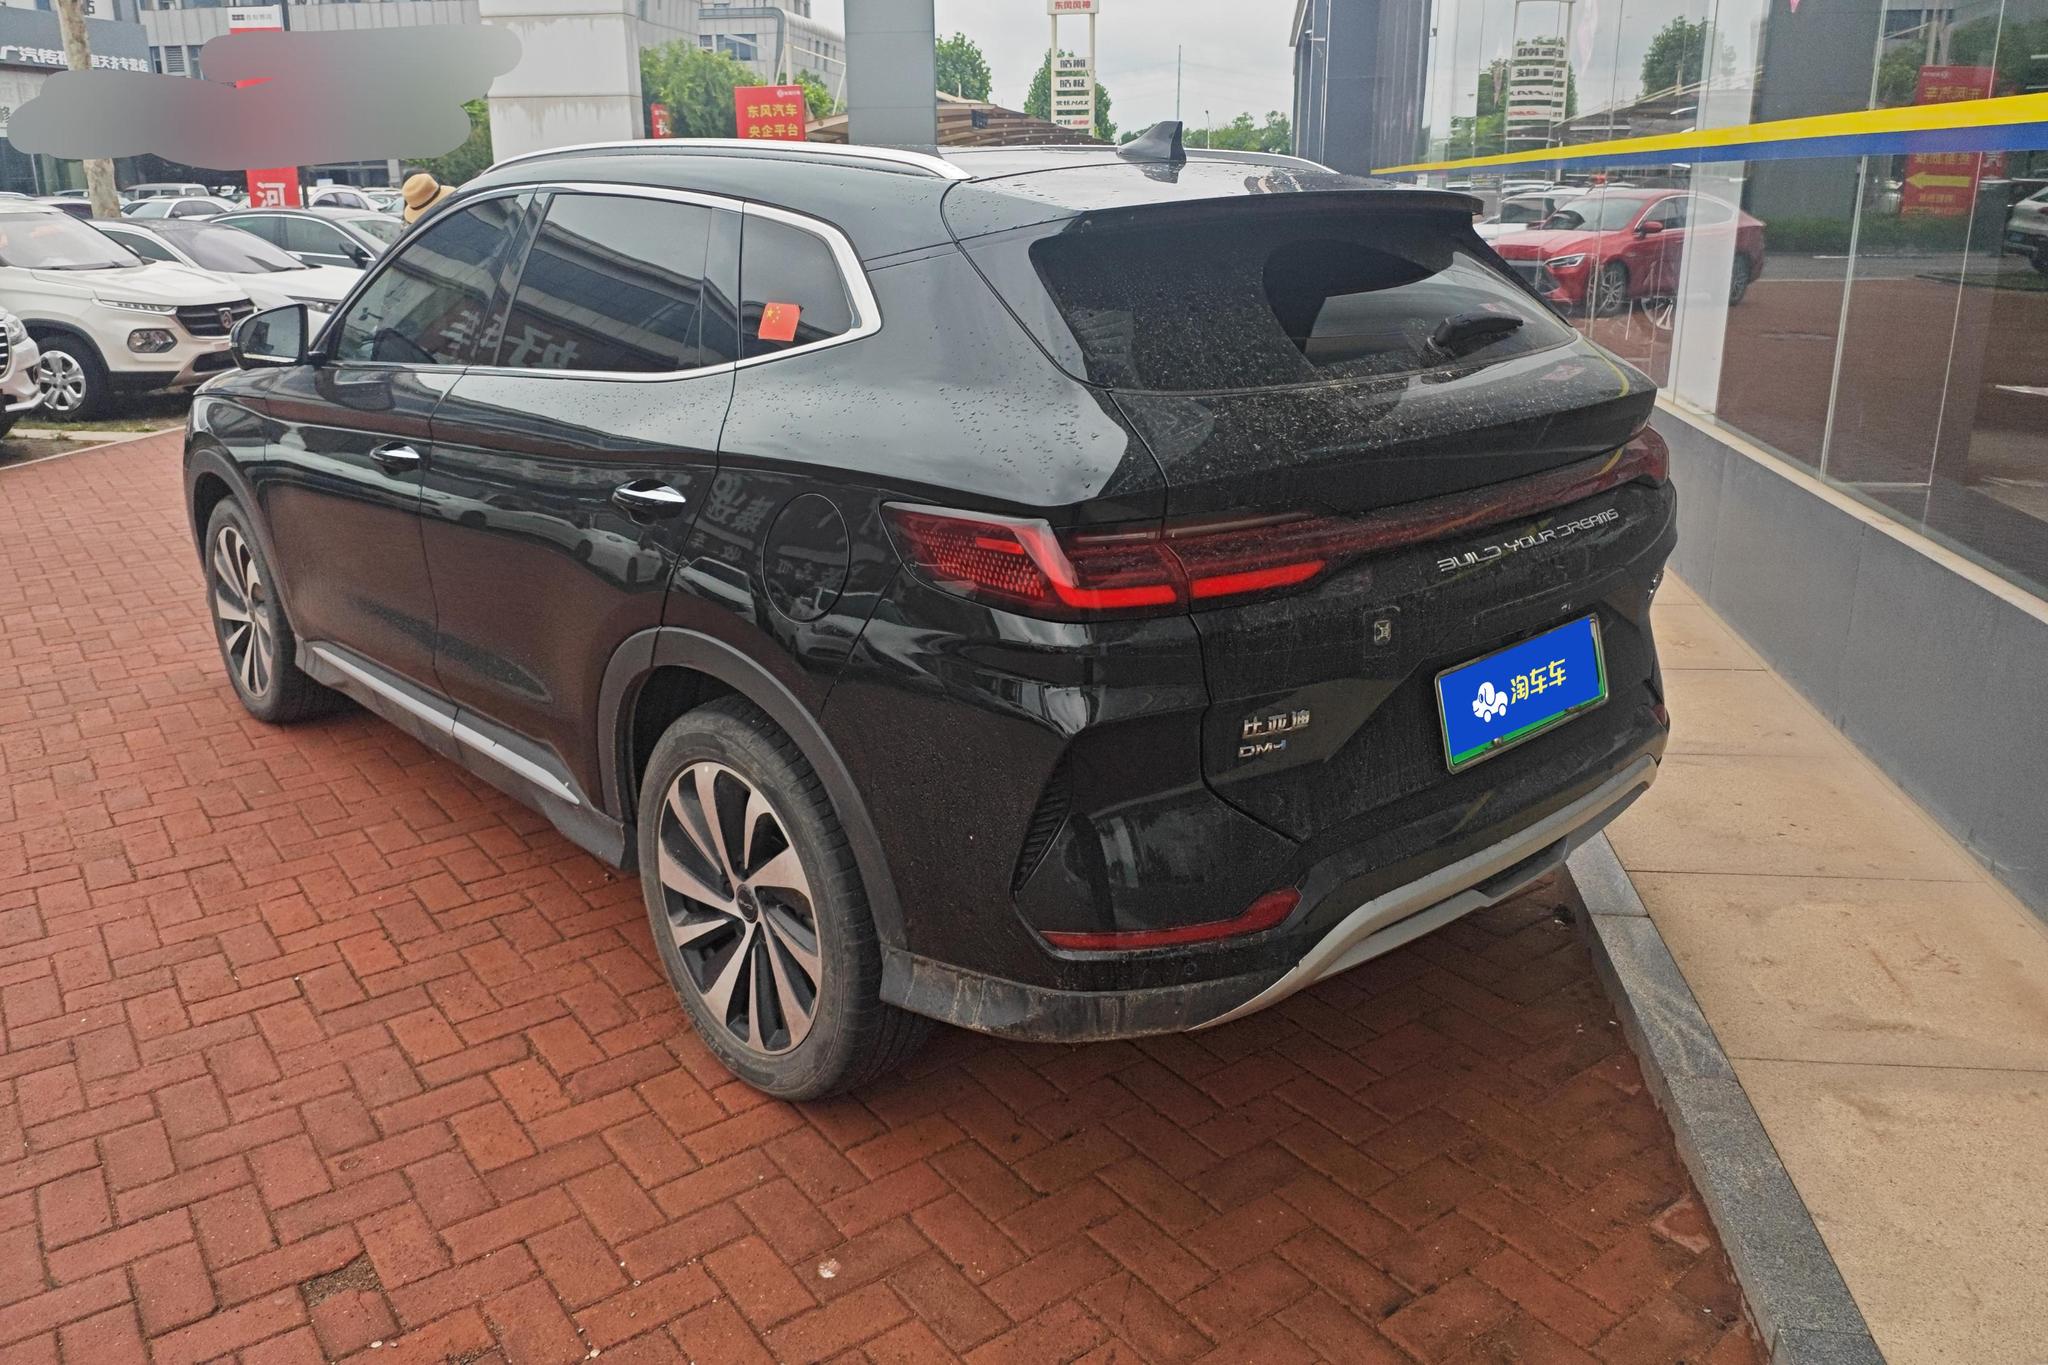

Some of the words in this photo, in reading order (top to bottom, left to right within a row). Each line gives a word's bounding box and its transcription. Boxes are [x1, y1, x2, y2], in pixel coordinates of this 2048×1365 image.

[746, 103, 798, 118] 东风汽车
[748, 123, 798, 138] 央企平台
[256, 181, 287, 208] 河
[1436, 545, 1502, 573] BUILD
[1503, 529, 1558, 552] YOUR
[1556, 508, 1620, 538] DREAMS
[1242, 709, 1310, 739] 比亚迪
